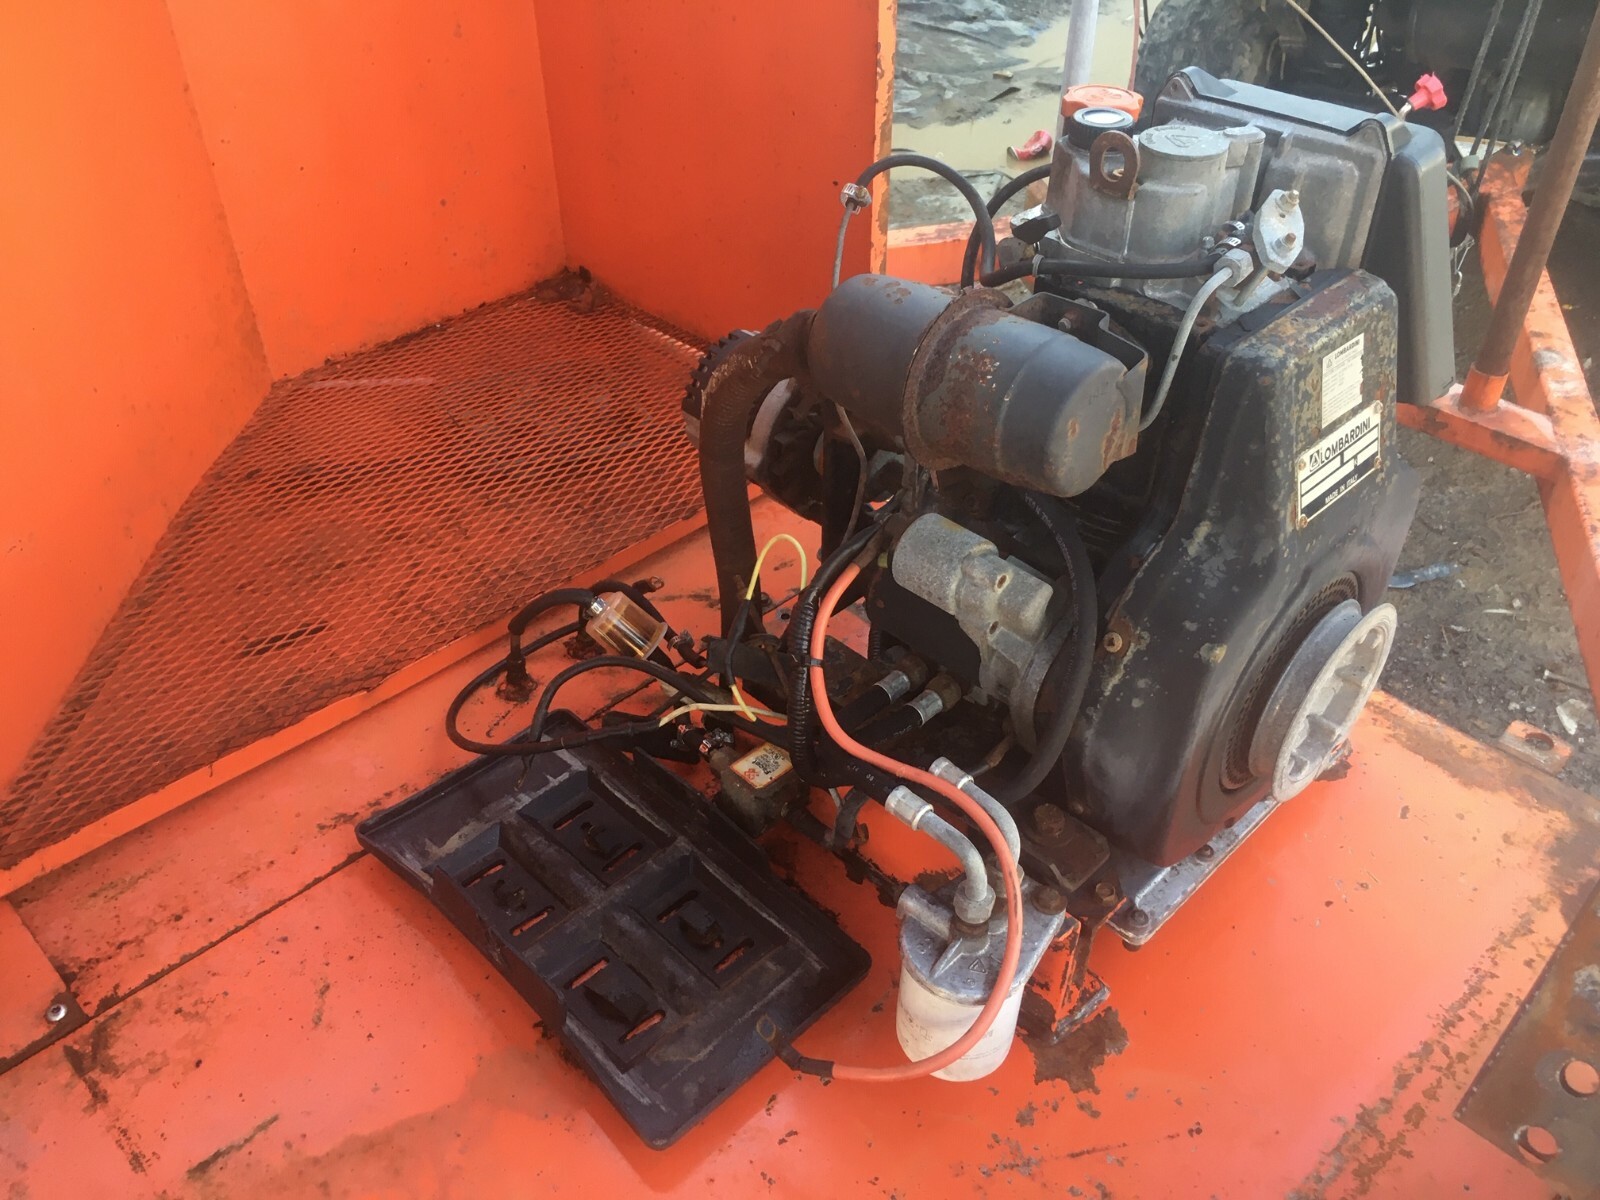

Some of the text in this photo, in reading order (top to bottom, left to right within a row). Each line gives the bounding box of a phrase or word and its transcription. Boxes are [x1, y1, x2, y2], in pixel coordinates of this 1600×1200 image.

[1333, 338, 1358, 359] LOMBARDINI
[1320, 417, 1370, 464] LOMBARDINI
[1325, 475, 1358, 504] MADE IN ITALY
